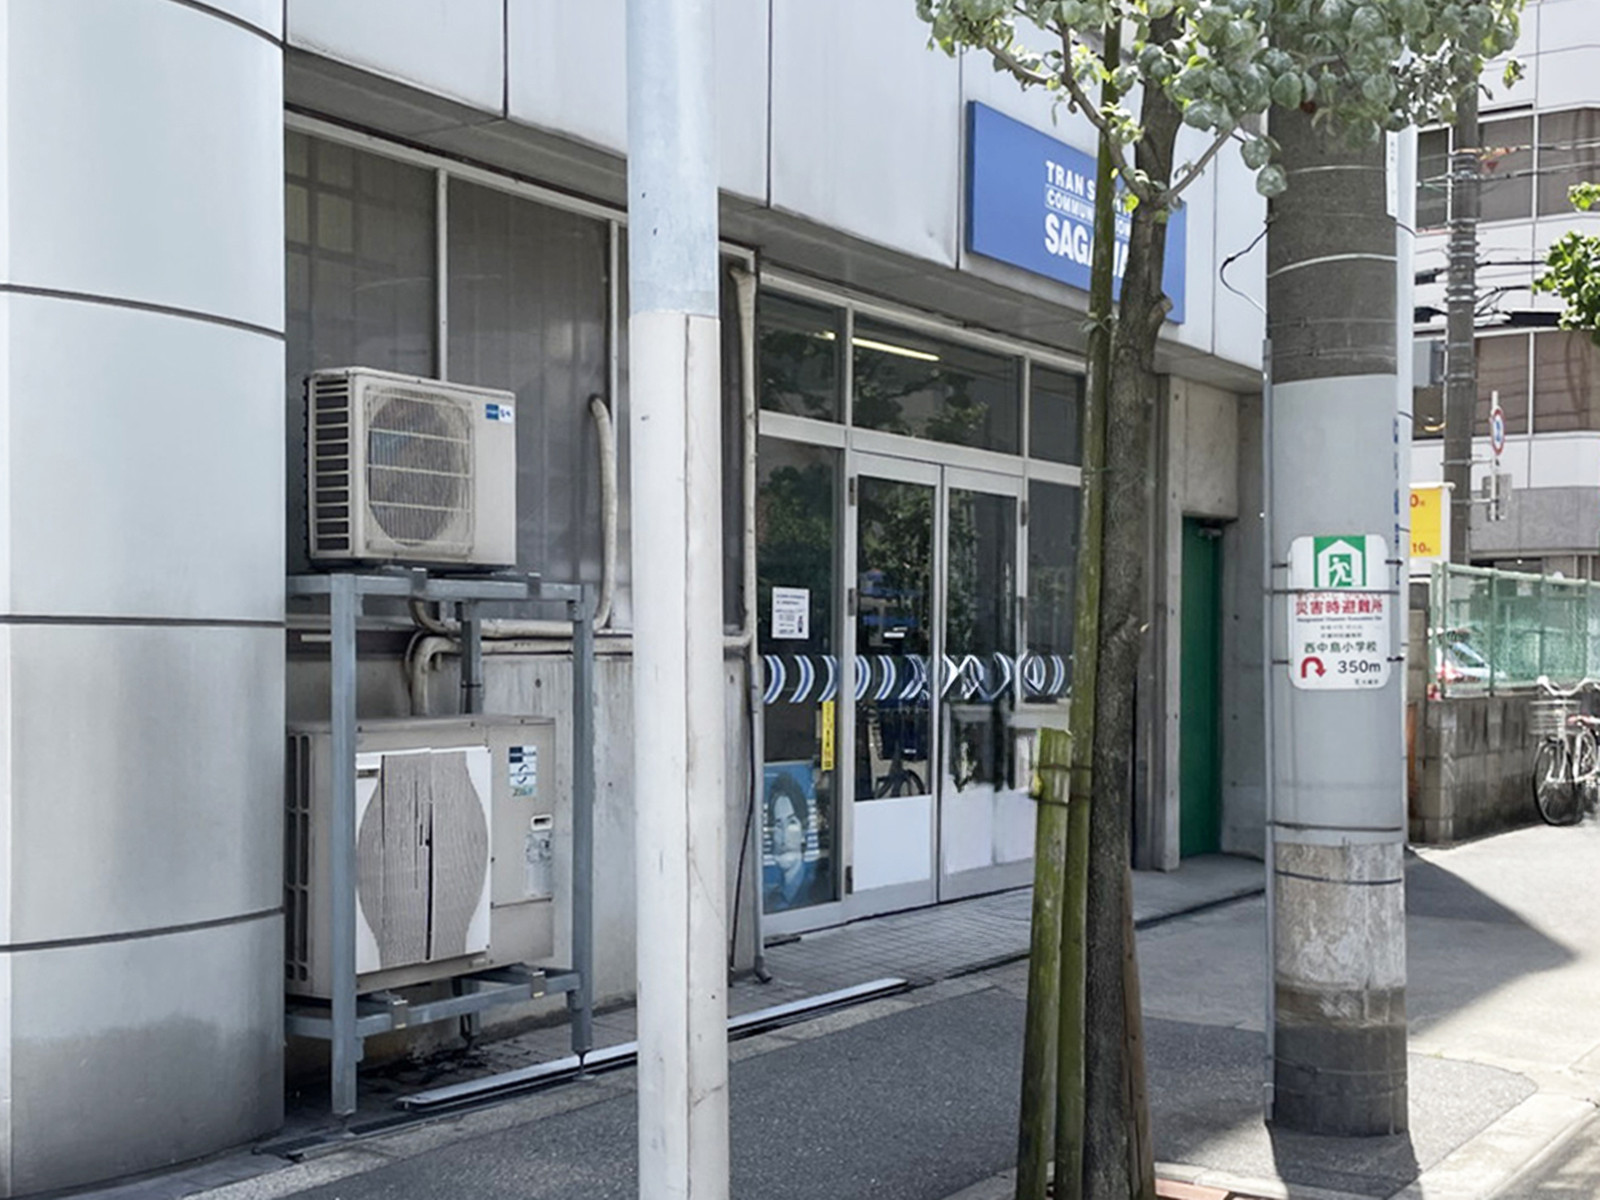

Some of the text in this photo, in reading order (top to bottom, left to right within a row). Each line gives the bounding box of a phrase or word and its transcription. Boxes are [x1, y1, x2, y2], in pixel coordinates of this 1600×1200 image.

[1296, 599, 1383, 615] 災害時避難所
[1304, 641, 1377, 654] 西中島小学校
[1338, 660, 1381, 674] 350m
